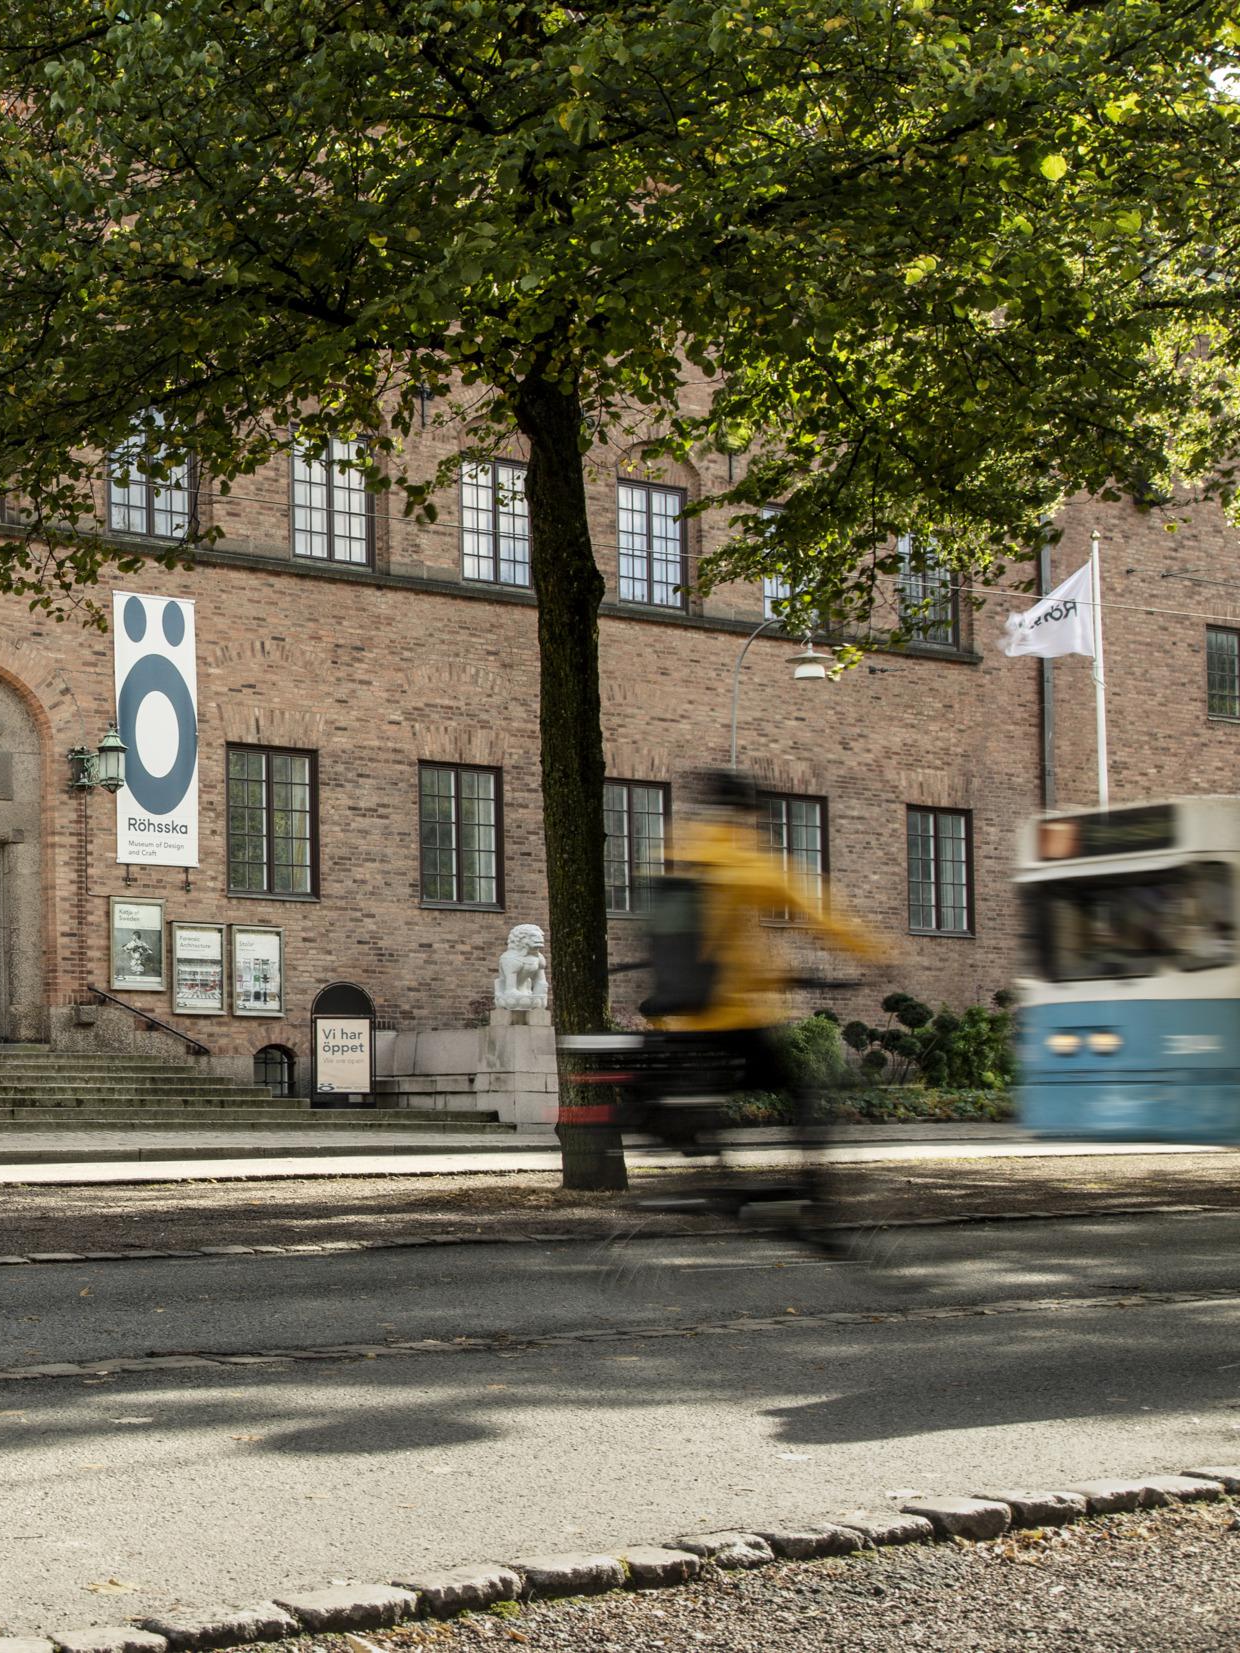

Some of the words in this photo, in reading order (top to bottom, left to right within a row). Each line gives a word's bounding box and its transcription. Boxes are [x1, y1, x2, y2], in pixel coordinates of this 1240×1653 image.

[127, 817, 188, 835] Röhsska
[128, 840, 155, 848] Museum
[155, 841, 163, 849] of
[163, 842, 185, 851] Design
[141, 849, 157, 857] Craft
[322, 1028, 336, 1040] Vi
[340, 1028, 364, 1040] har
[322, 1041, 365, 1056] öppet
